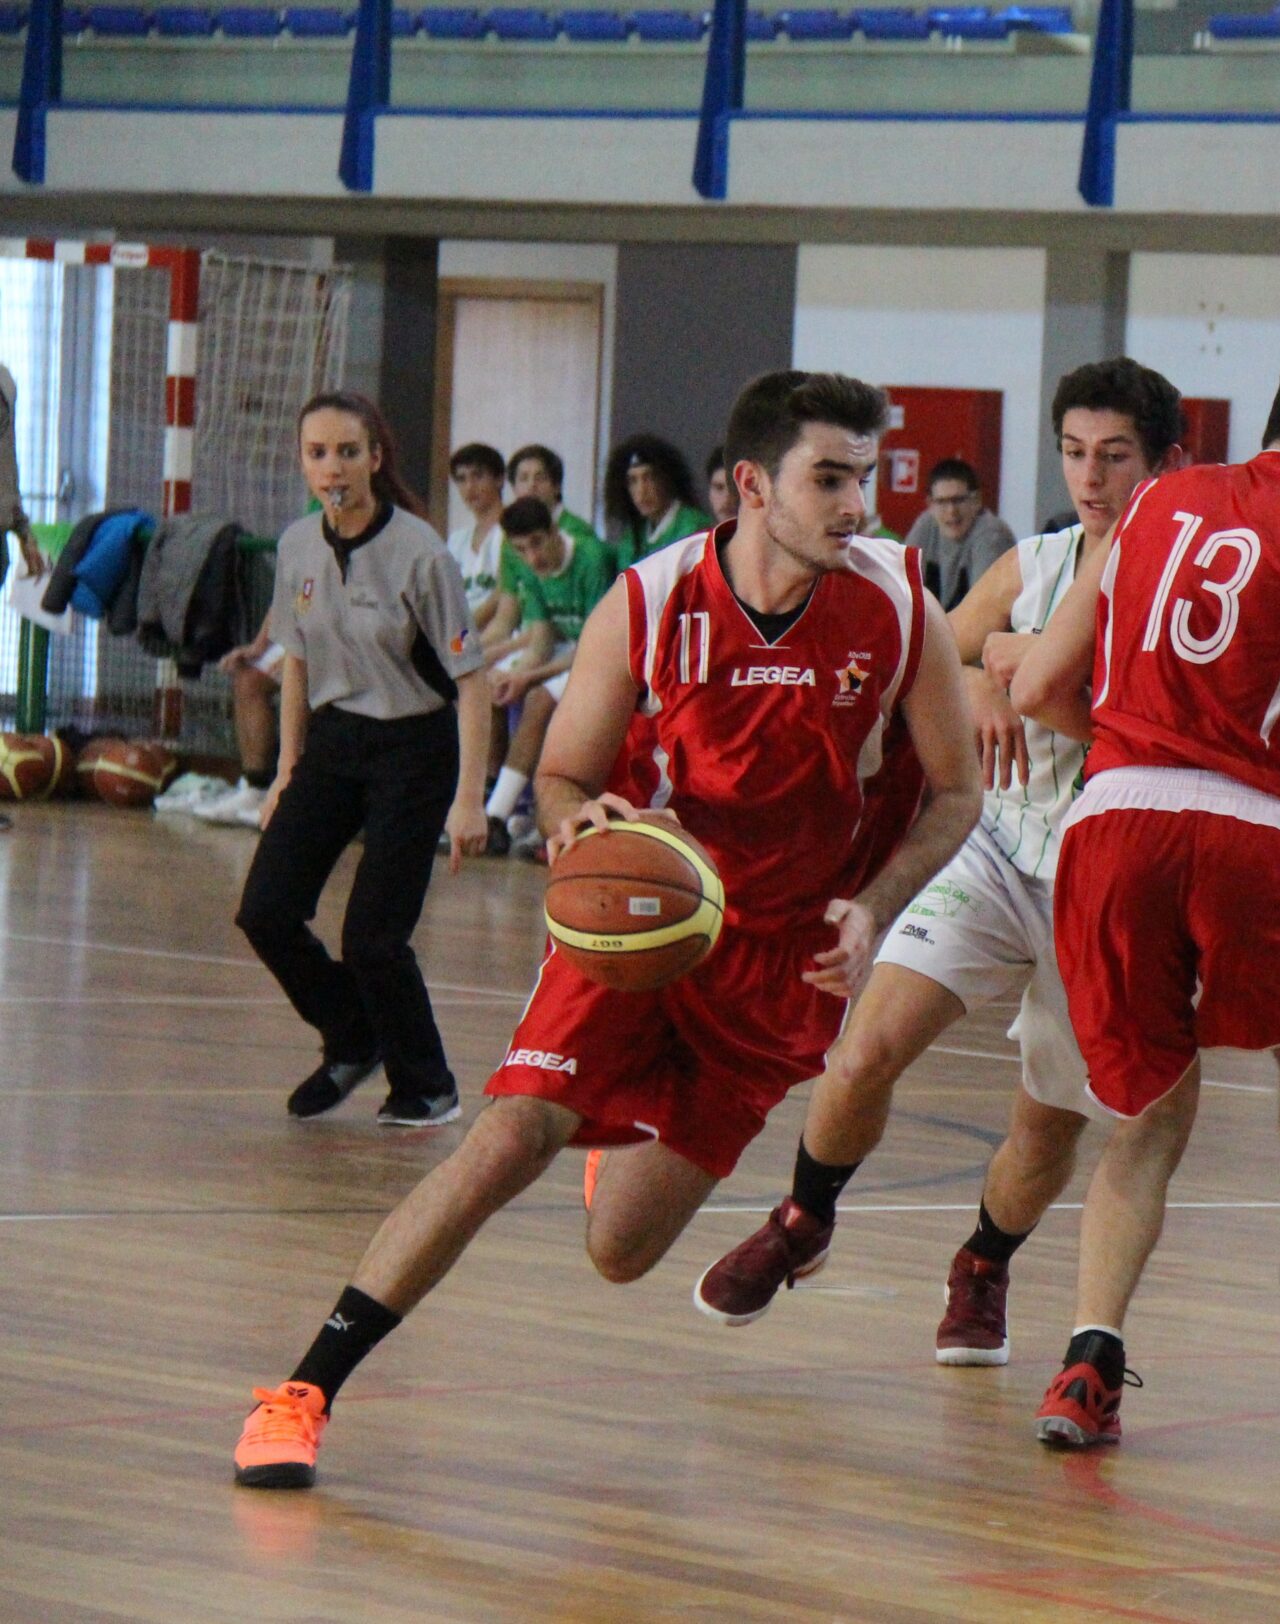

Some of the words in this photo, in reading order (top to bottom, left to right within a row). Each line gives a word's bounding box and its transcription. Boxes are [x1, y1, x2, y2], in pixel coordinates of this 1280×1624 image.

[1142, 511, 1261, 665] 13
[679, 611, 710, 684] 11
[731, 666, 816, 687] LEGEA
[505, 1048, 577, 1076] LEGEA
